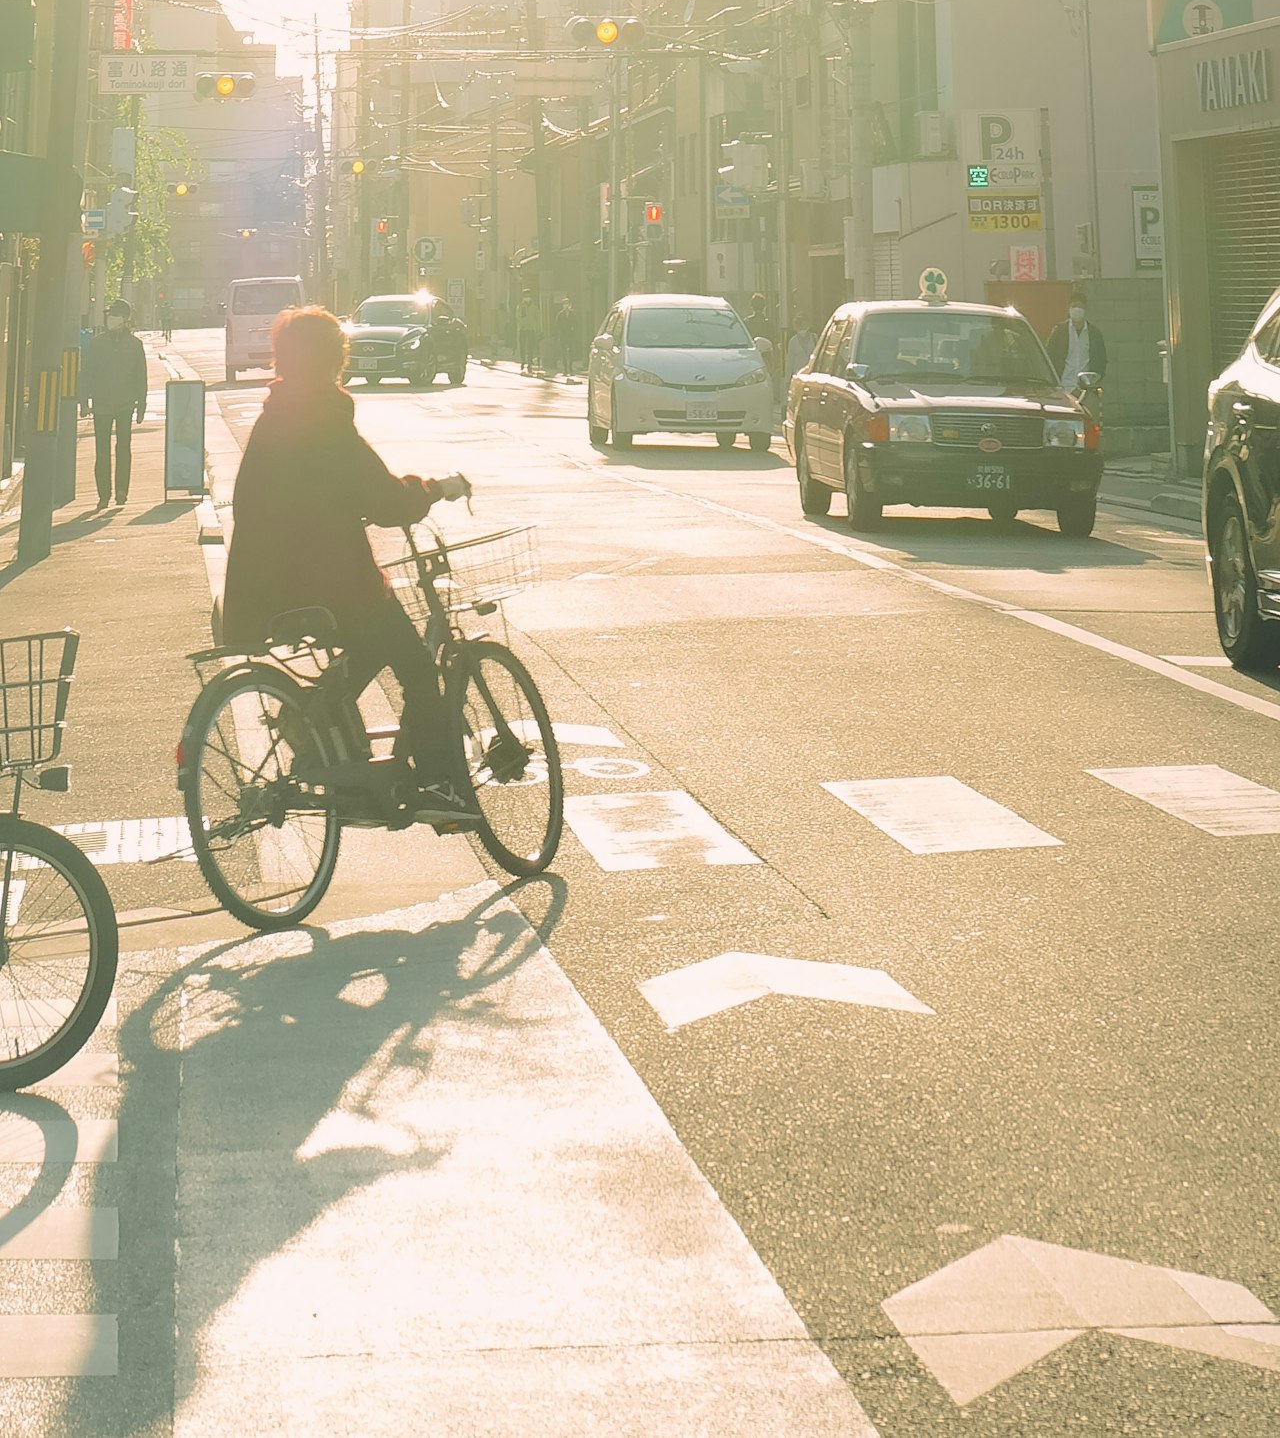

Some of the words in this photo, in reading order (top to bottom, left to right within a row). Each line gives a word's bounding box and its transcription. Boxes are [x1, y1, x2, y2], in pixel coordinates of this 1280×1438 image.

[107, 61, 187, 78] 富小路通
[109, 80, 165, 90] Tominokouji
[168, 79, 186, 89] dori
[1194, 48, 1270, 112] YAMAKI
[979, 116, 1013, 161] P
[995, 147, 1025, 161] 24h
[969, 166, 989, 187] 空
[1140, 207, 1160, 235] P
[976, 474, 1011, 489] 36-61
